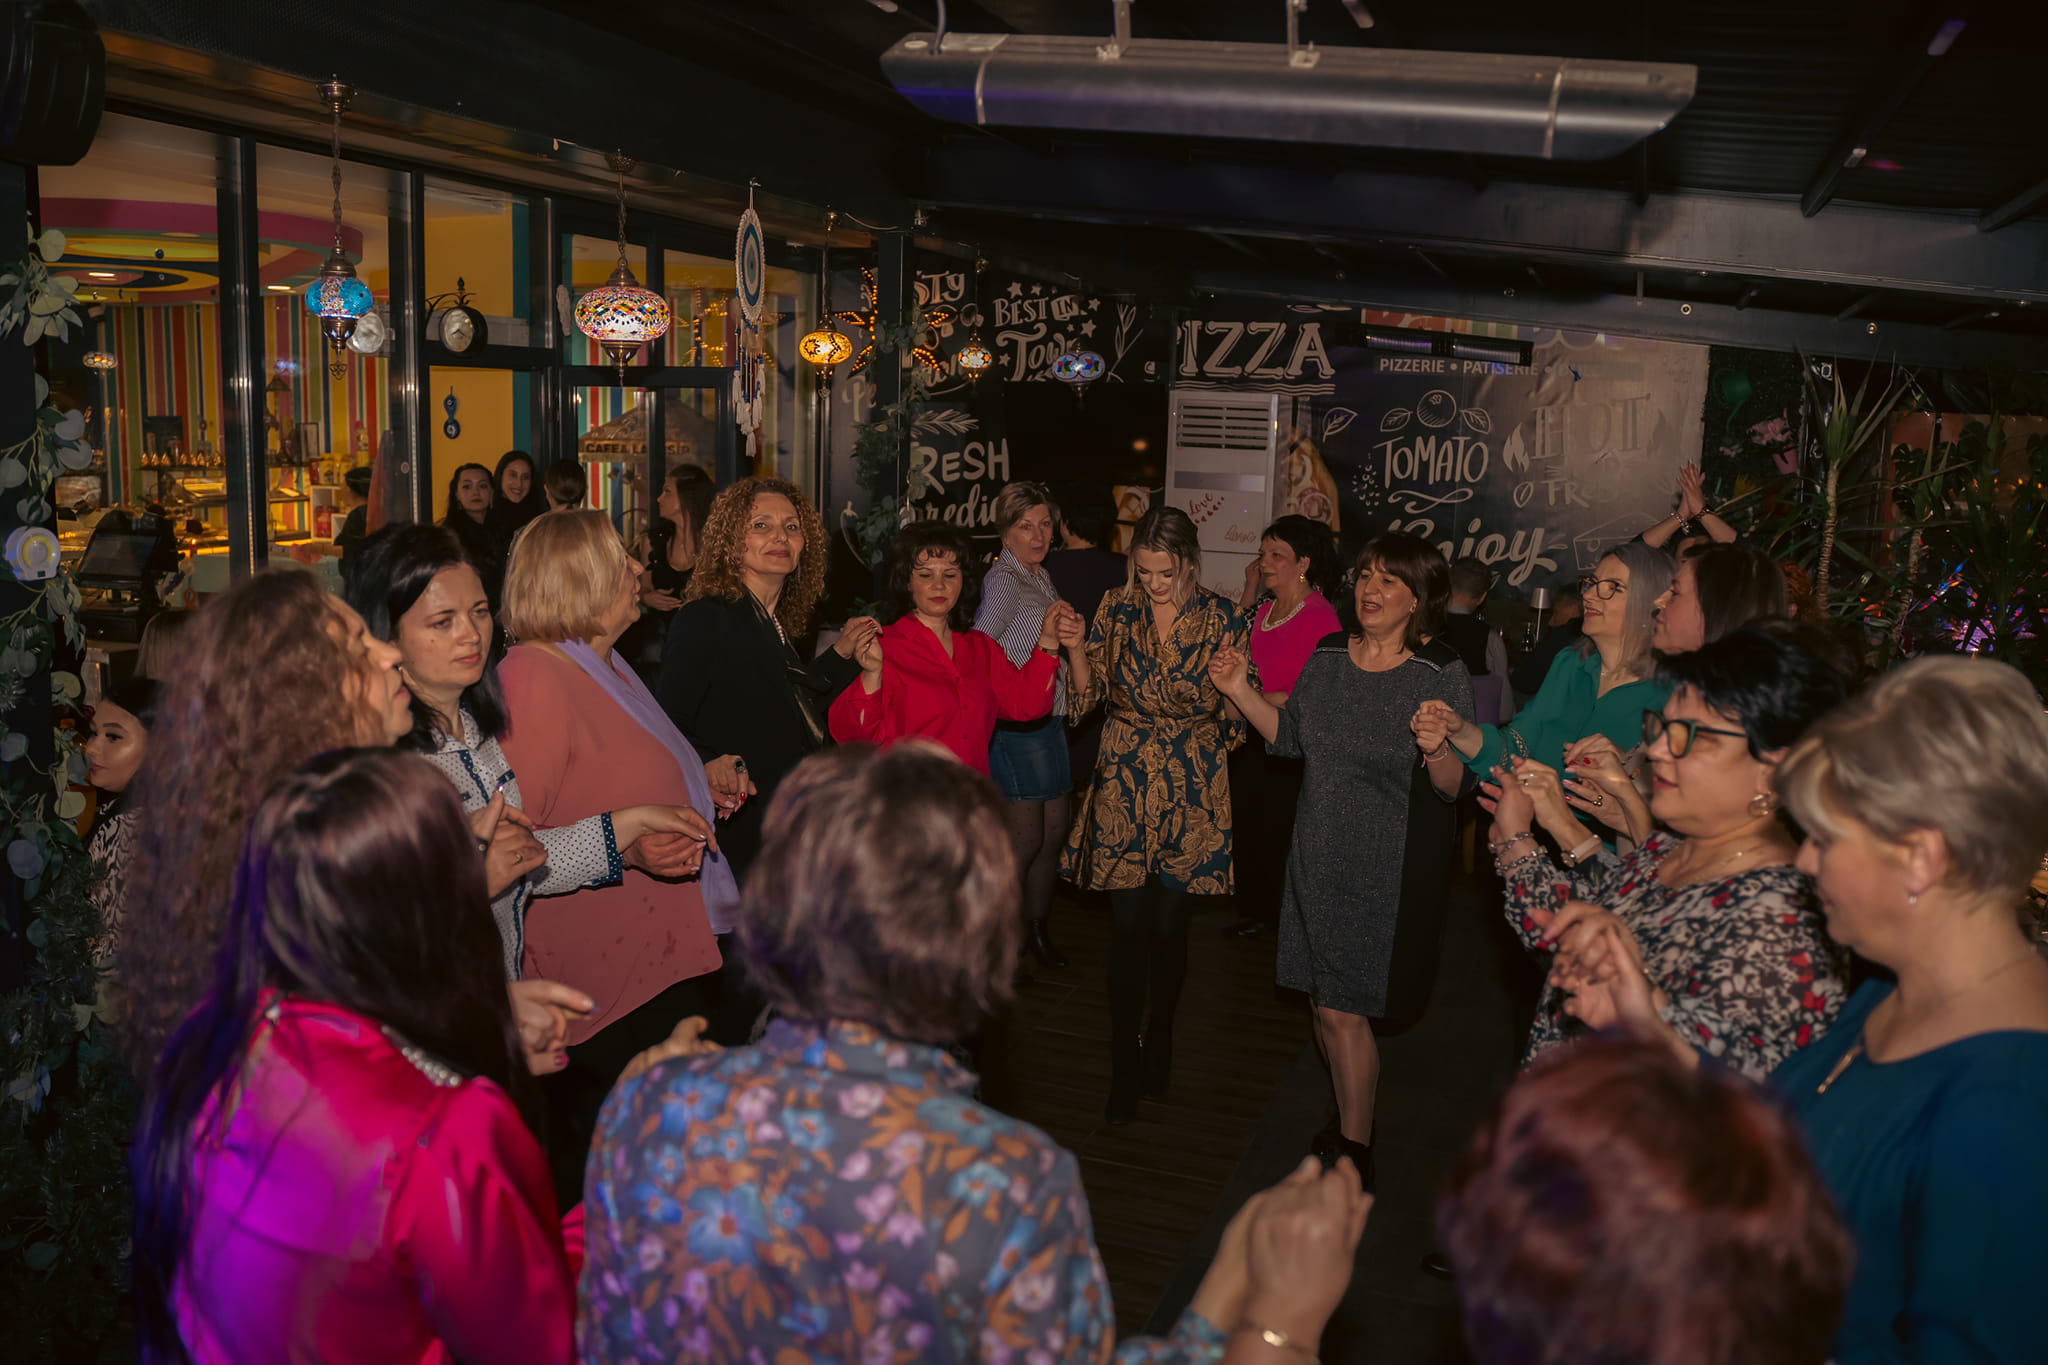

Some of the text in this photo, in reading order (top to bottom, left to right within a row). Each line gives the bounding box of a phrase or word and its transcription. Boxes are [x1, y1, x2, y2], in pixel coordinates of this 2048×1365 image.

[992, 297, 1049, 327] BEST
[1176, 319, 1337, 381] IZZA
[1379, 357, 1446, 373] PIZZERIE
[1463, 360, 1539, 376] PATISERIE
[585, 443, 628, 455] CAFEA
[666, 444, 691, 457] SIP
